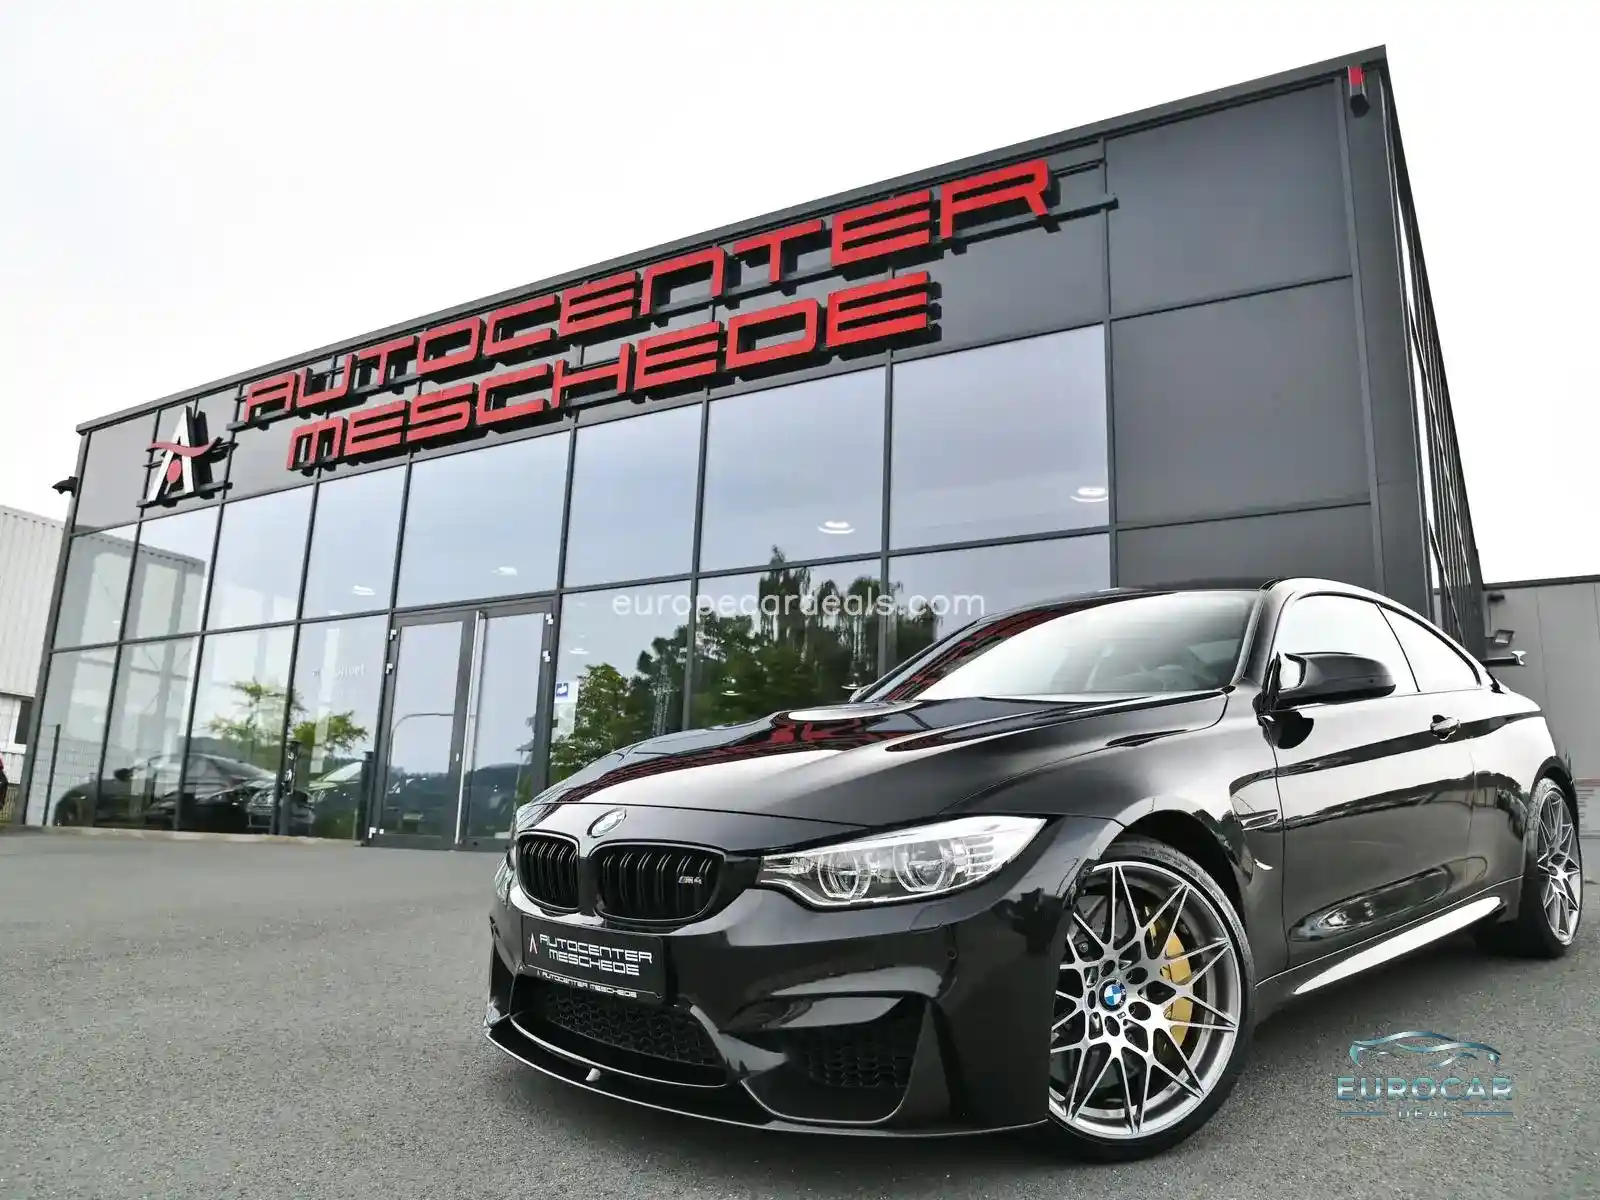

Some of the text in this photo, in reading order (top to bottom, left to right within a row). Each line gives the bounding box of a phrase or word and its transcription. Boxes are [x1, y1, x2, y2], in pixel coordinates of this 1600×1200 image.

[245, 159, 1051, 421] AUTOCENTER
[286, 271, 930, 471] MESCHEDE
[539, 933, 653, 964] AUTOCENTER
[548, 948, 640, 976] MESCHEDE
[541, 971, 637, 998] AUTOCENTER MESCHEDE
